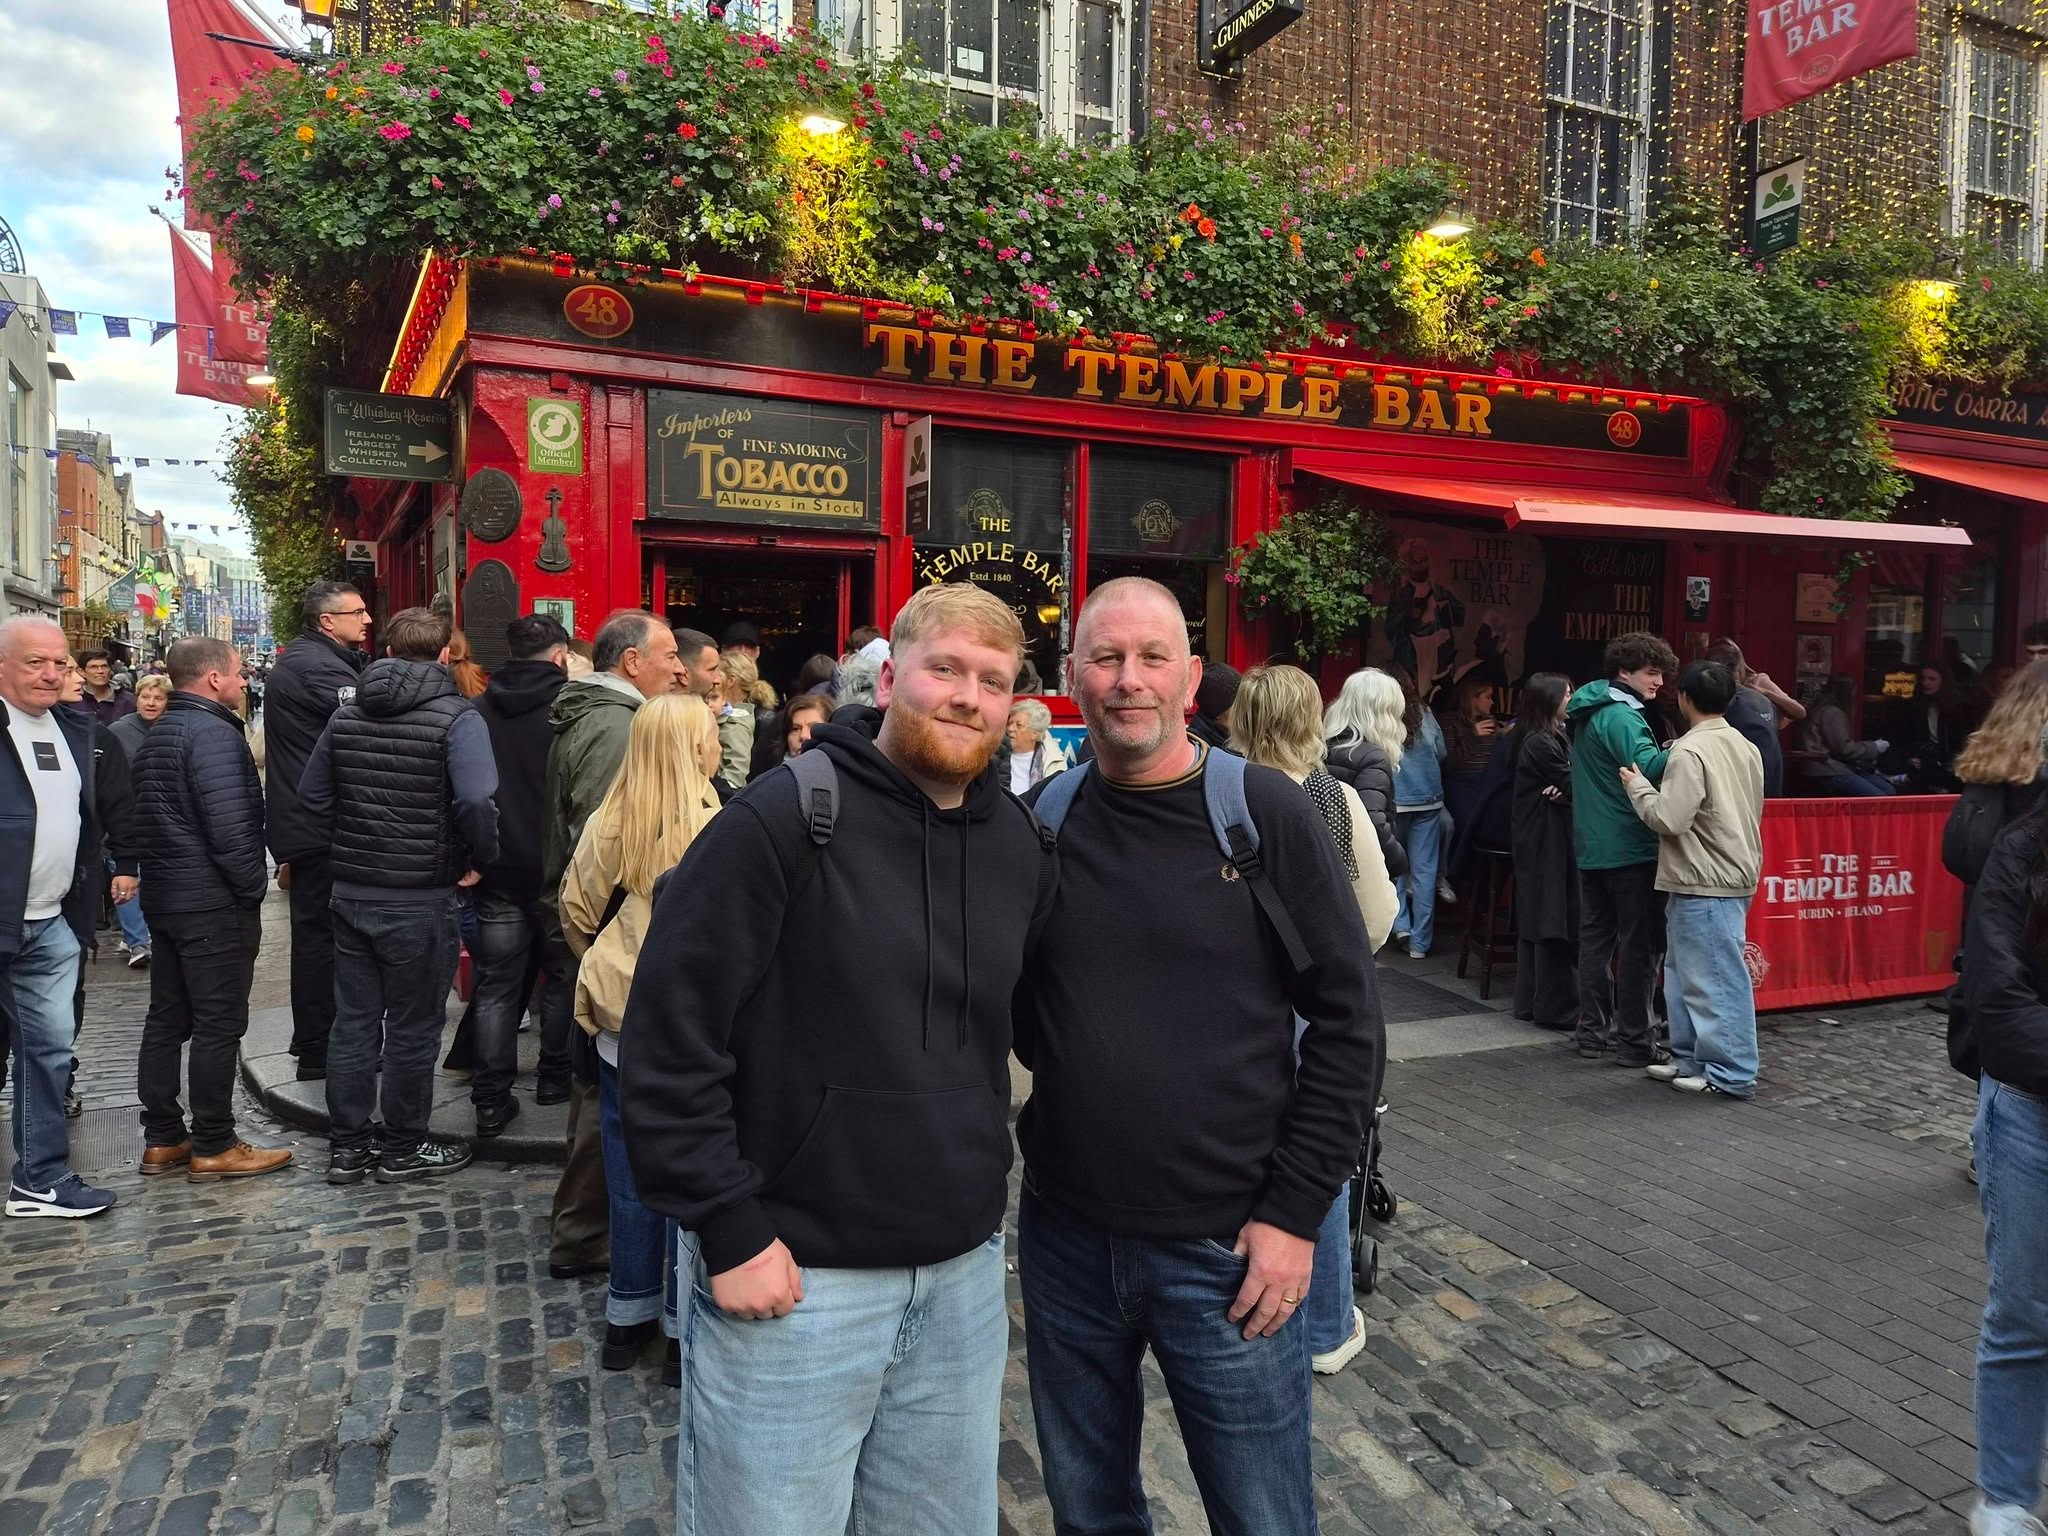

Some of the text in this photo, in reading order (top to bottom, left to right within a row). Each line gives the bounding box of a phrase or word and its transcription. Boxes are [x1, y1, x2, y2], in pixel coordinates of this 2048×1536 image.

[1786, 3, 1859, 56] BAR
[576, 292, 618, 326] 48
[204, 368, 240, 386] BAR
[867, 323, 1492, 435] THE TEMPLE BAR
[349, 400, 402, 423] Whiskey
[403, 408, 447, 427] Reserve
[657, 407, 752, 442] Importers
[345, 429, 401, 441] IRELAND'S
[717, 428, 735, 439] OF
[1611, 417, 1632, 440] 48
[348, 447, 398, 458] WHISKEY
[349, 439, 398, 449] LARGEST
[540, 448, 571, 458] Official
[742, 438, 847, 460] FINE SMOKING
[339, 455, 407, 468] COLLECTION
[538, 456, 573, 466] Member
[684, 442, 849, 499] TOBACCO
[719, 493, 860, 515] Always in Stock
[979, 516, 1011, 532] THE
[1472, 538, 1512, 560] THE
[920, 541, 1064, 593] TEMPLE BAR
[969, 572, 1012, 583] Estd. 1840
[1449, 559, 1531, 584] TEMPLE
[1471, 581, 1511, 606] BAR
[1614, 583, 1650, 612] THE
[1820, 853, 1859, 874] THE
[1764, 870, 1915, 903] TEMPLE BAR
[1798, 907, 1834, 920] DUBLIN
